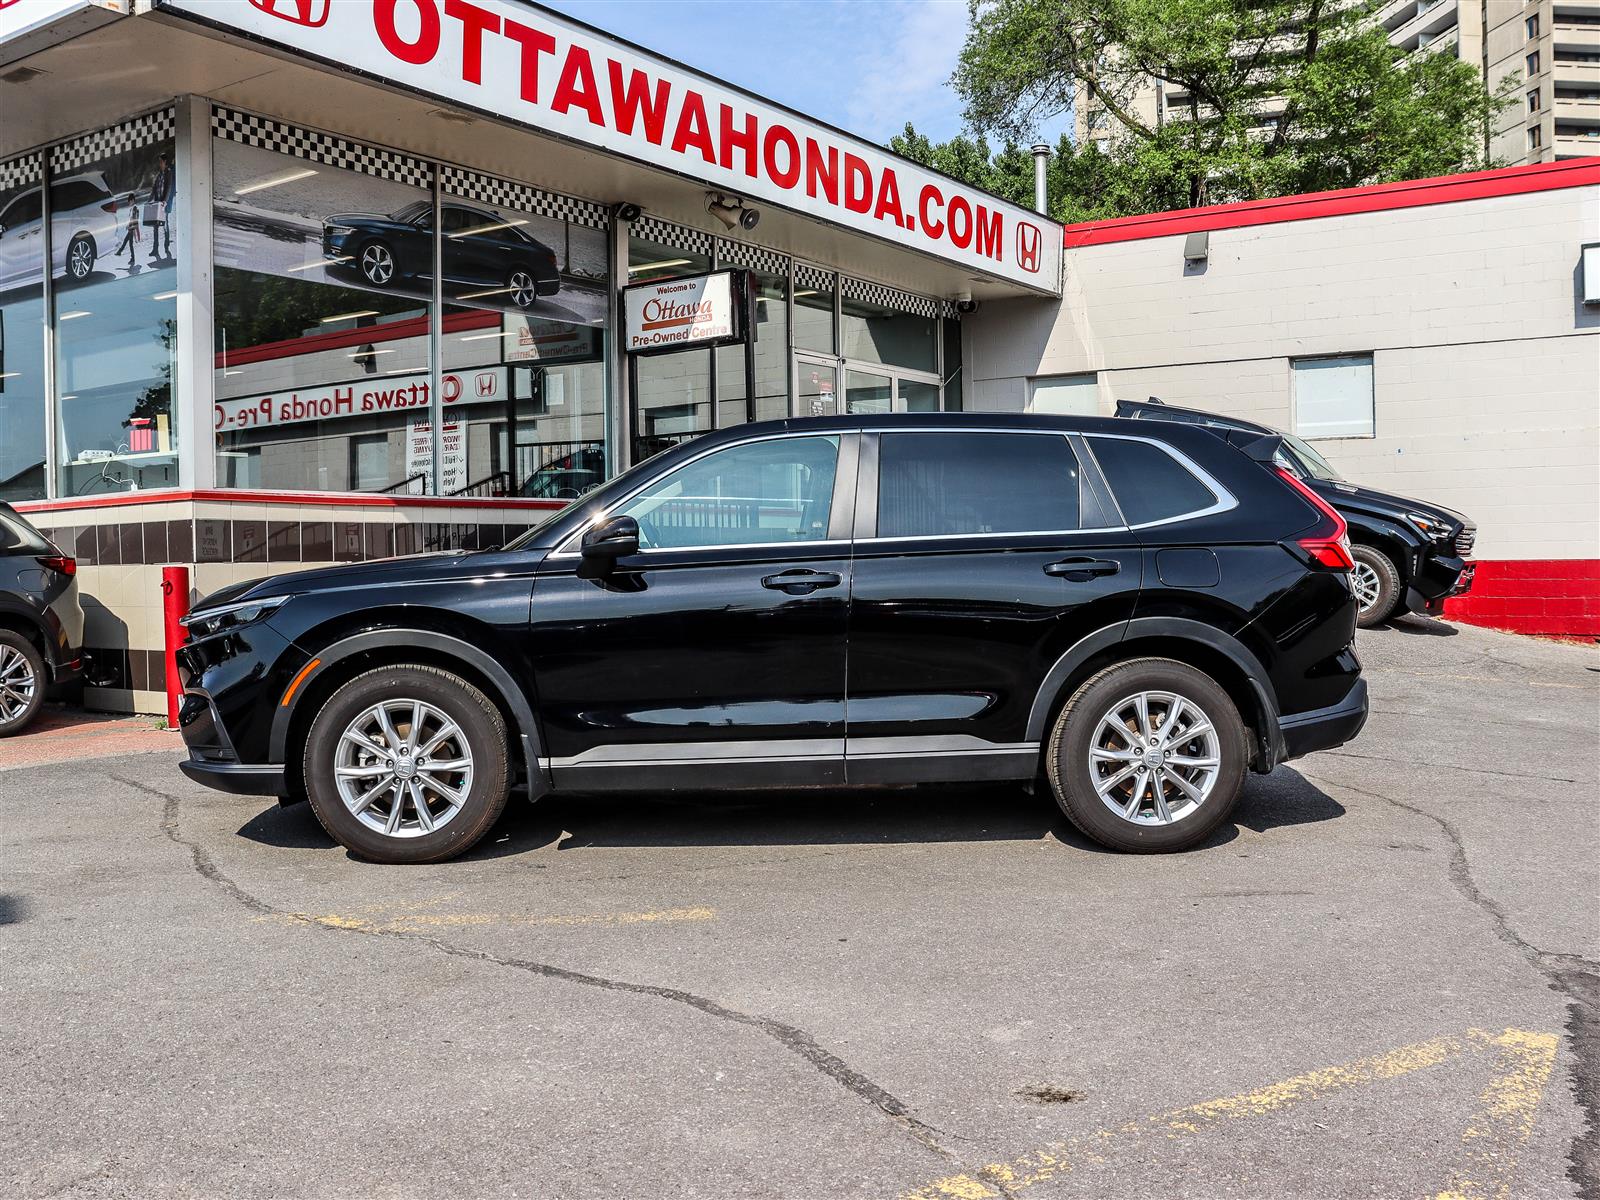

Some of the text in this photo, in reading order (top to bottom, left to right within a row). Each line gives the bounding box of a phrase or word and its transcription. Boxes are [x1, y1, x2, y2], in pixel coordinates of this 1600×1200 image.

[374, 0, 1003, 262] OTTAWAHONDA.COM
[657, 282, 697, 295] Welcome to
[642, 297, 713, 323] Ottawa
[689, 314, 712, 323] HONDA
[632, 325, 728, 347] Pre-Owned Centre
